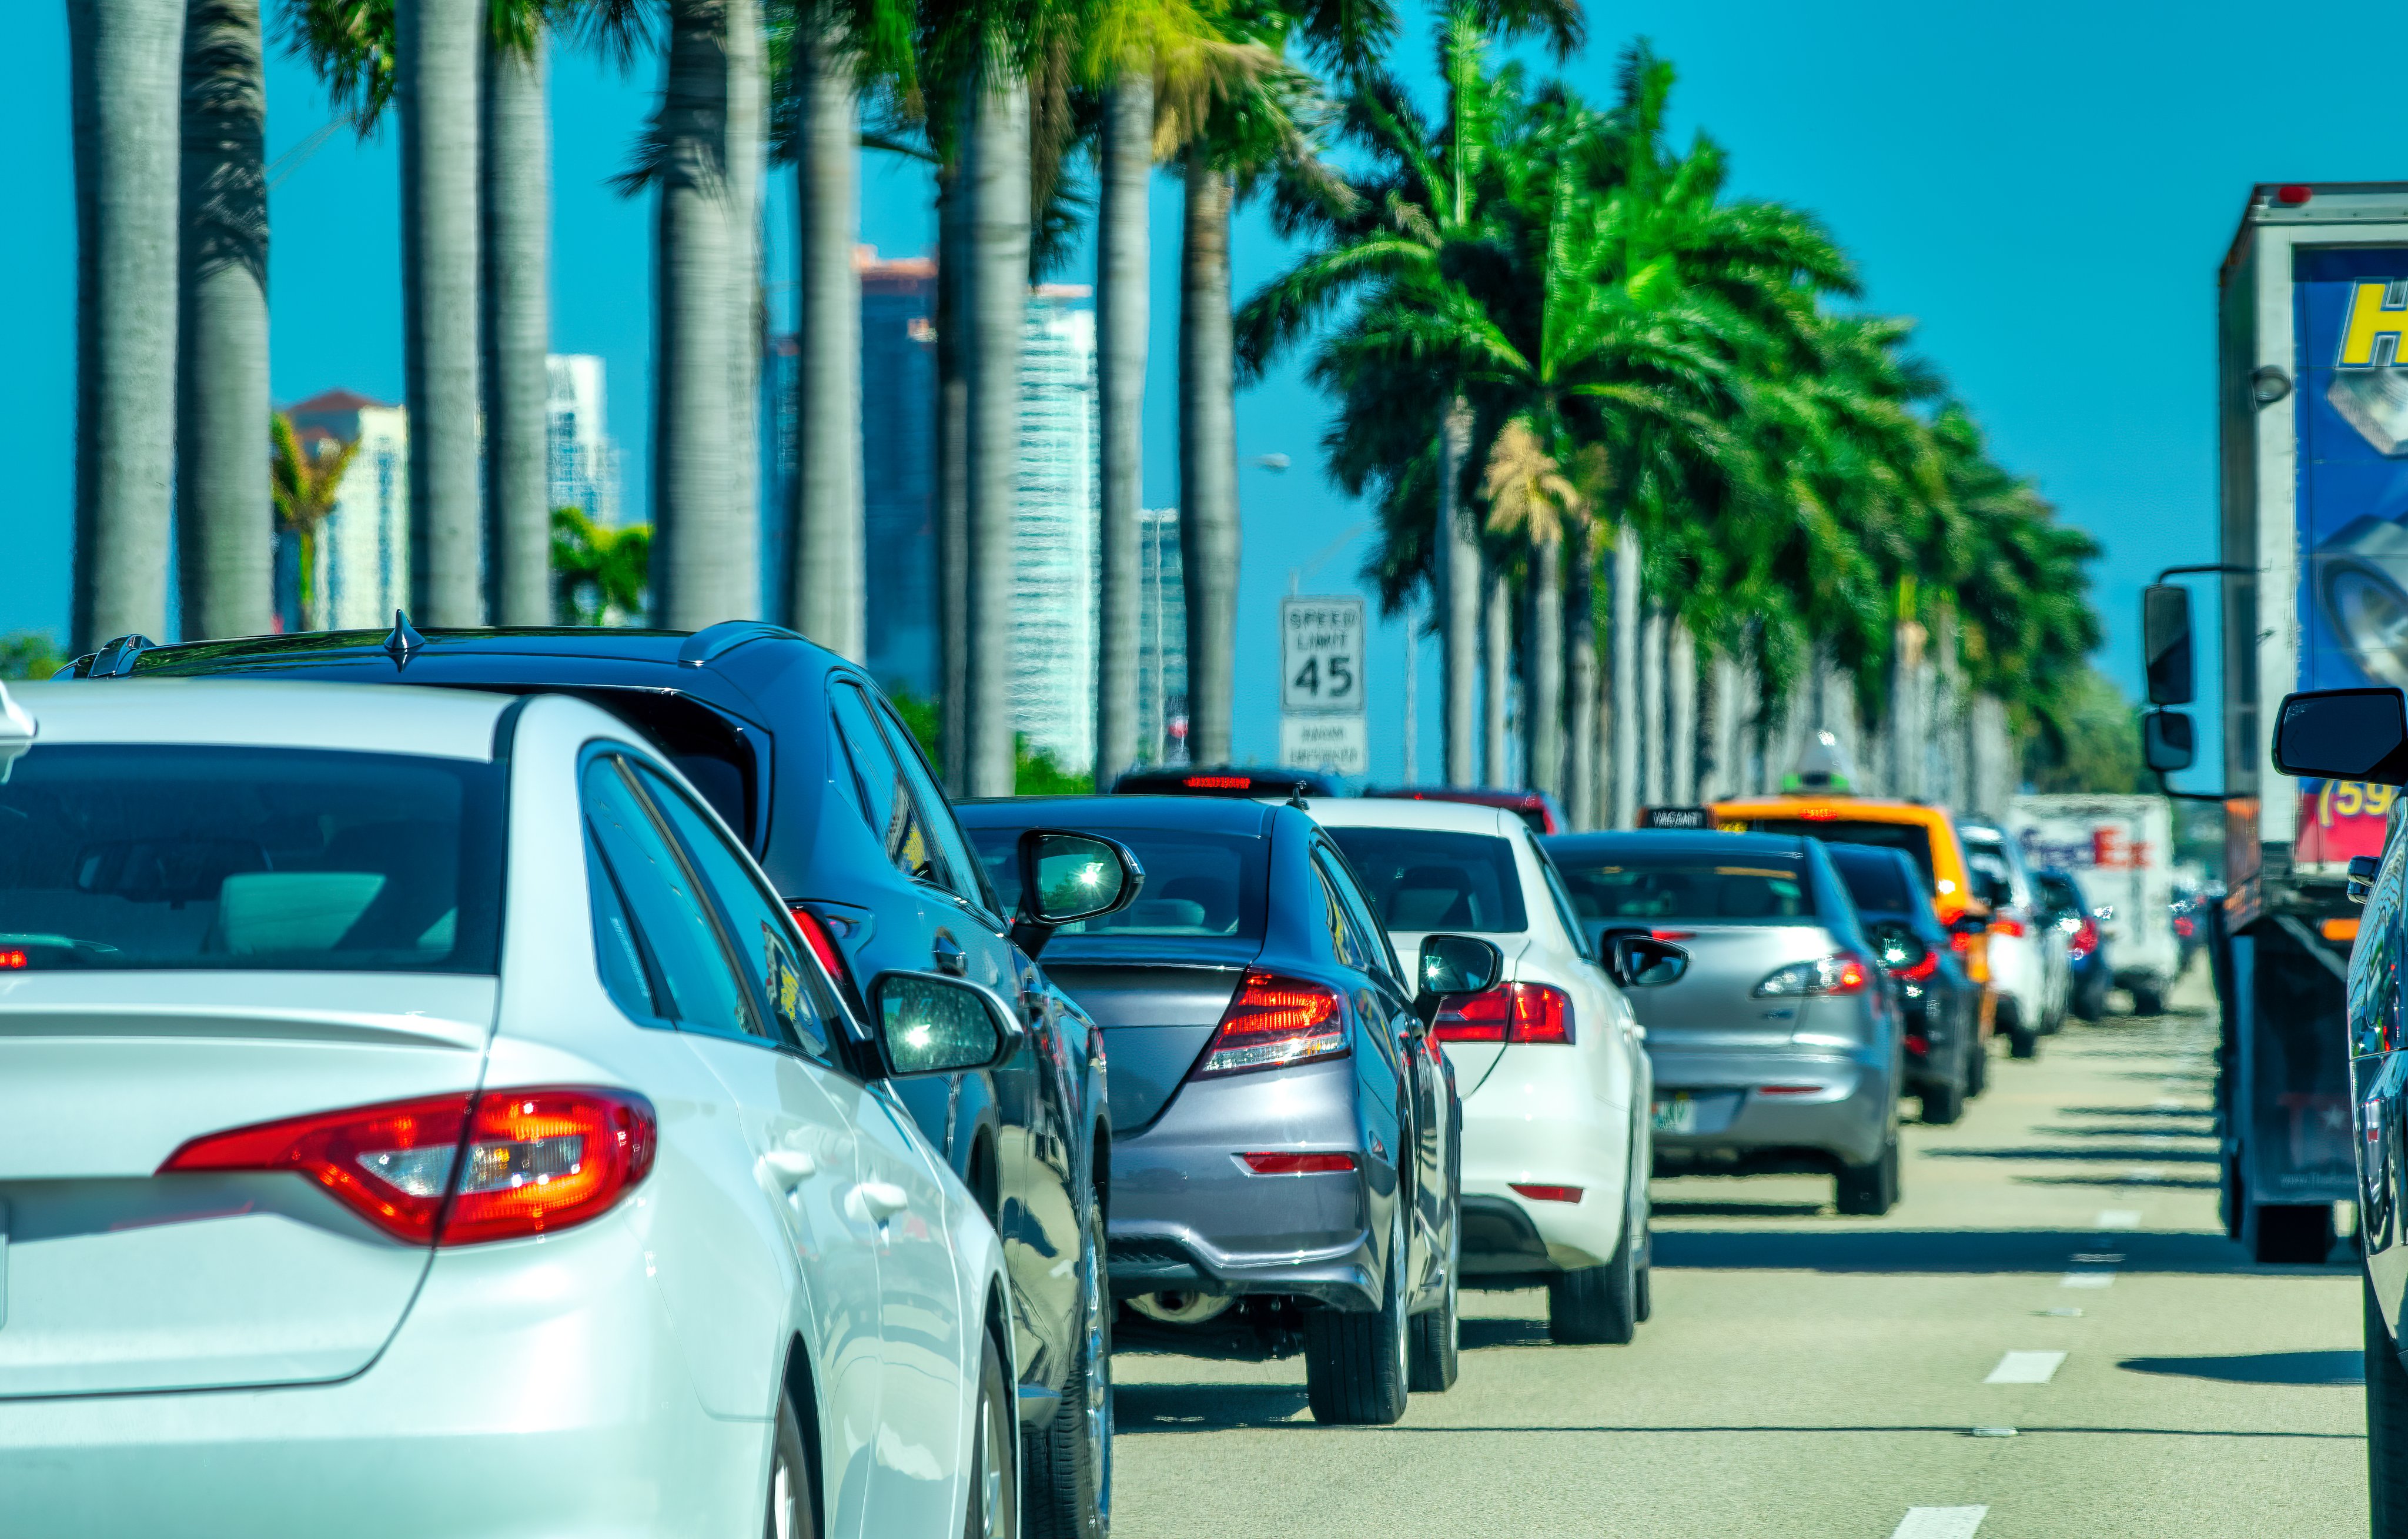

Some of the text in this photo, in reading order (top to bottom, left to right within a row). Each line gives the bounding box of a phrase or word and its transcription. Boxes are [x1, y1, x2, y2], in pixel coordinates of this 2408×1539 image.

[1290, 608, 1356, 630] SPEED
[1297, 632, 1347, 650] LIMIT
[1295, 655, 1353, 696] 45
